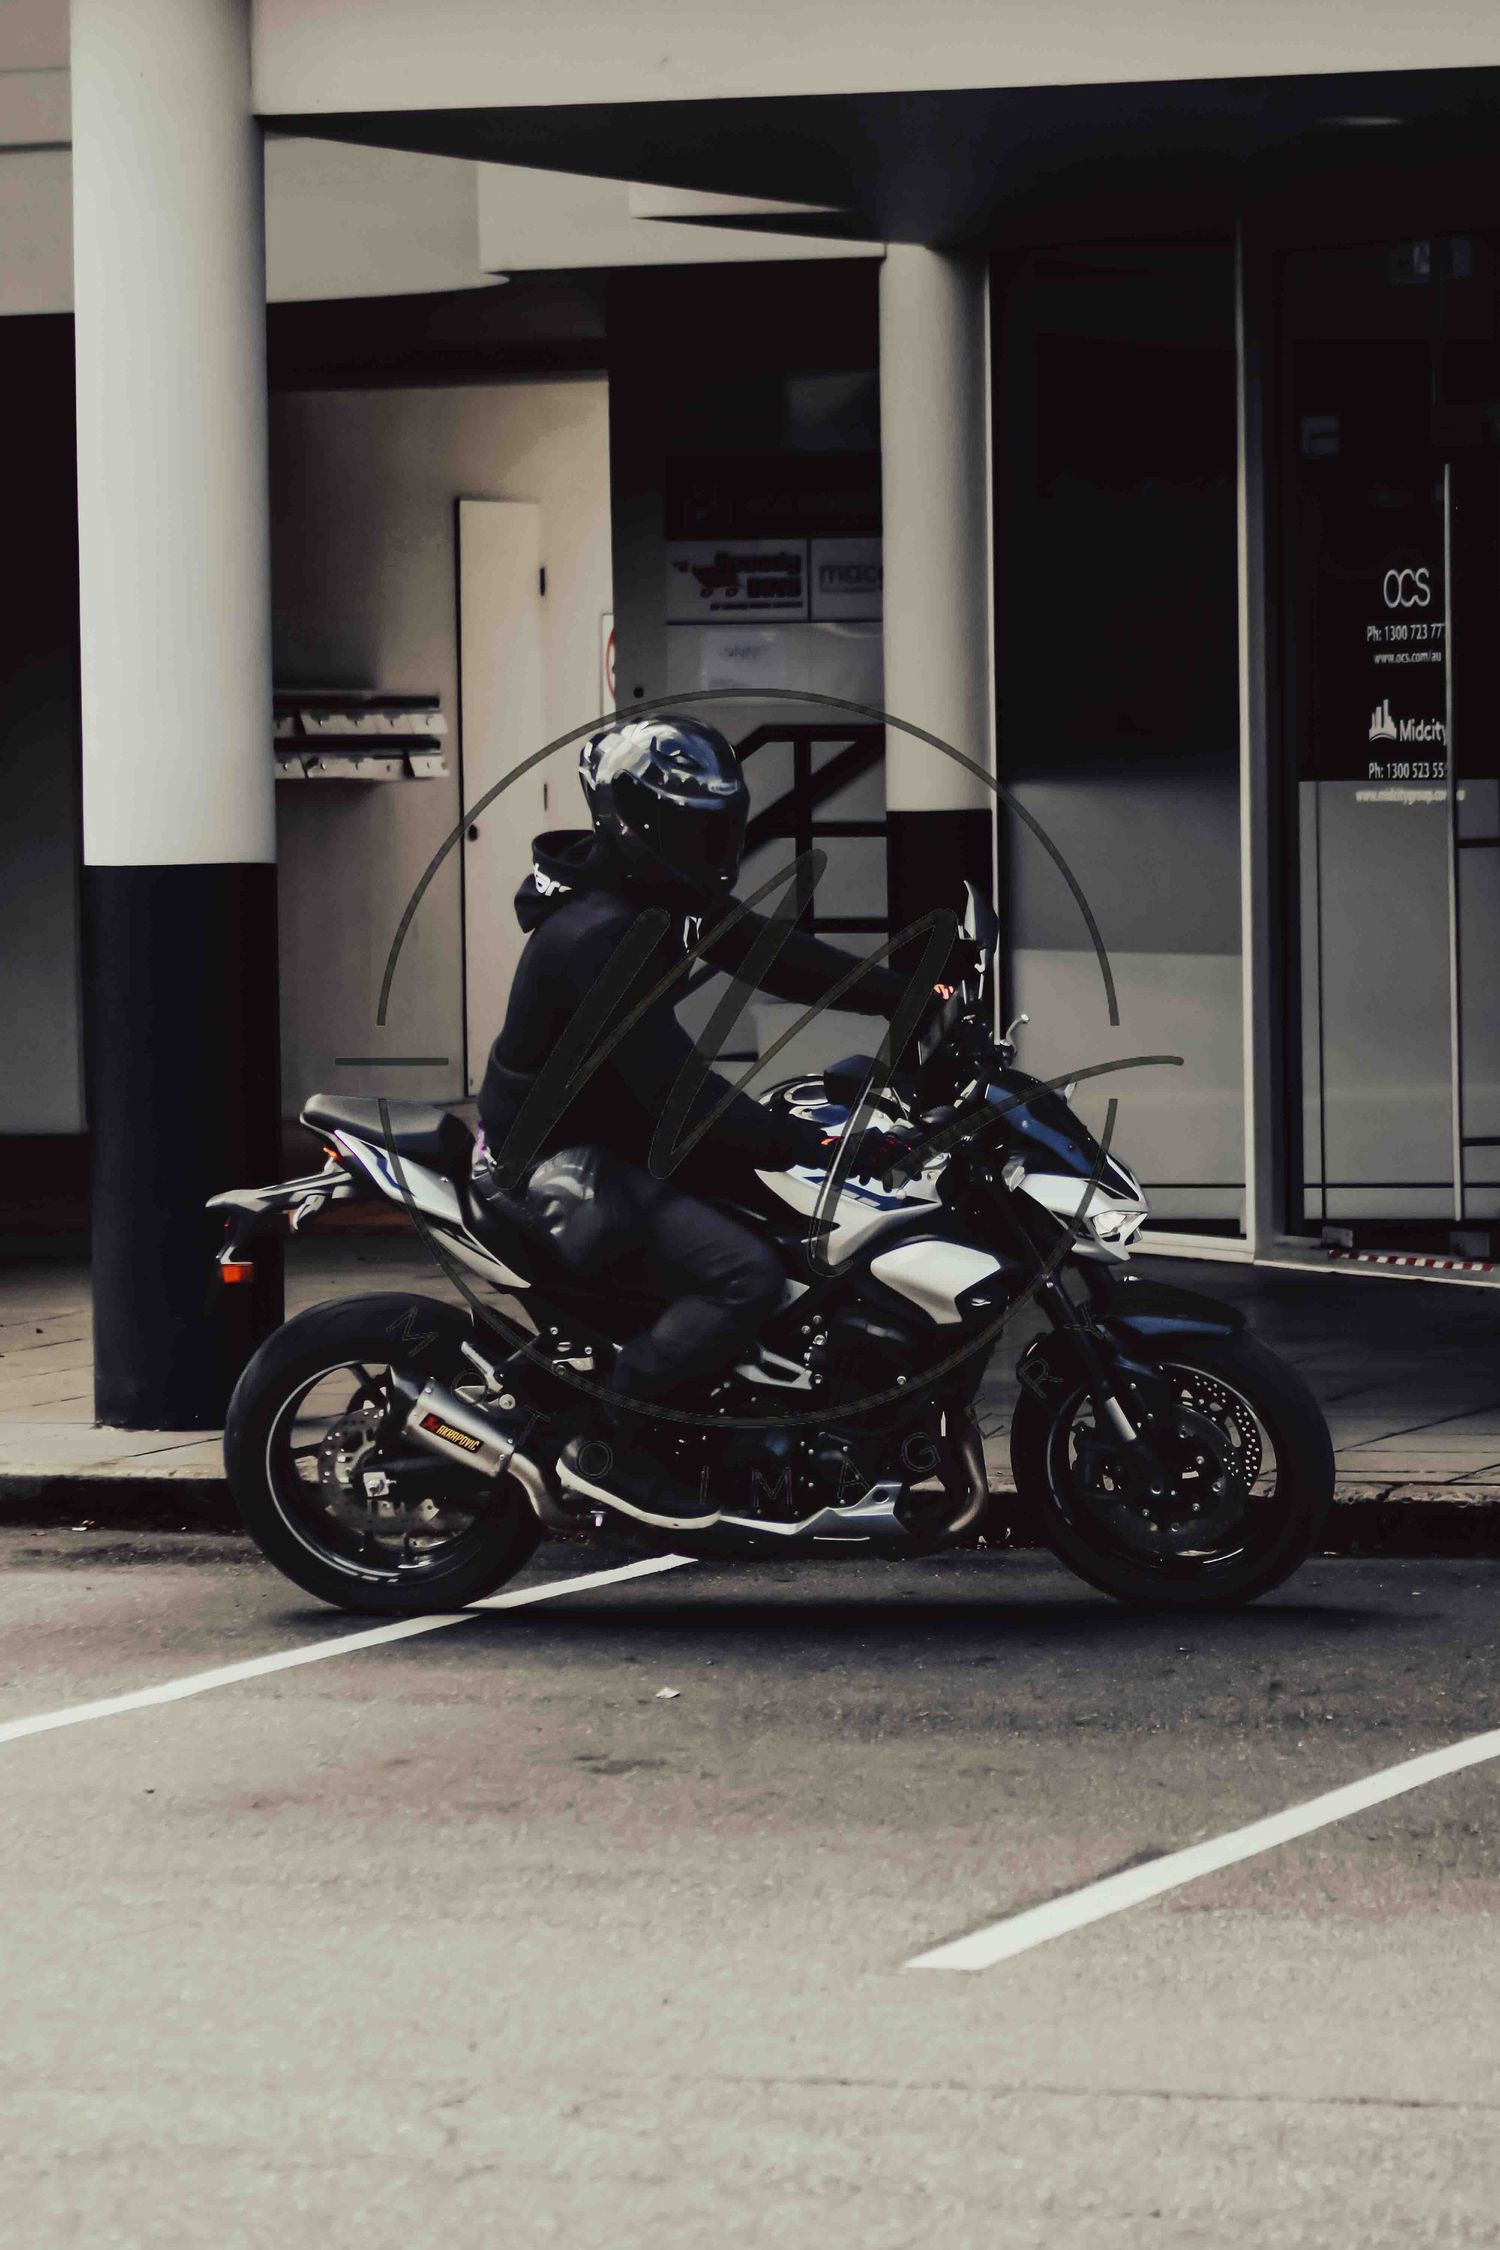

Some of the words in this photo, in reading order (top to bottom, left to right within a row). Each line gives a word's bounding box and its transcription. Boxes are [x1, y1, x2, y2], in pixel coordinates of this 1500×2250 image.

[1383, 567, 1431, 608] OCS
[1366, 625, 1382, 641] Ph:
[1384, 624, 1408, 640] 1300
[1410, 623, 1428, 640] 723
[1399, 717, 1447, 746] Midcity
[1368, 762, 1384, 779] Ph:
[1386, 762, 1410, 779] 1300
[1412, 762, 1430, 778] 523
[1432, 762, 1446, 778] 55
